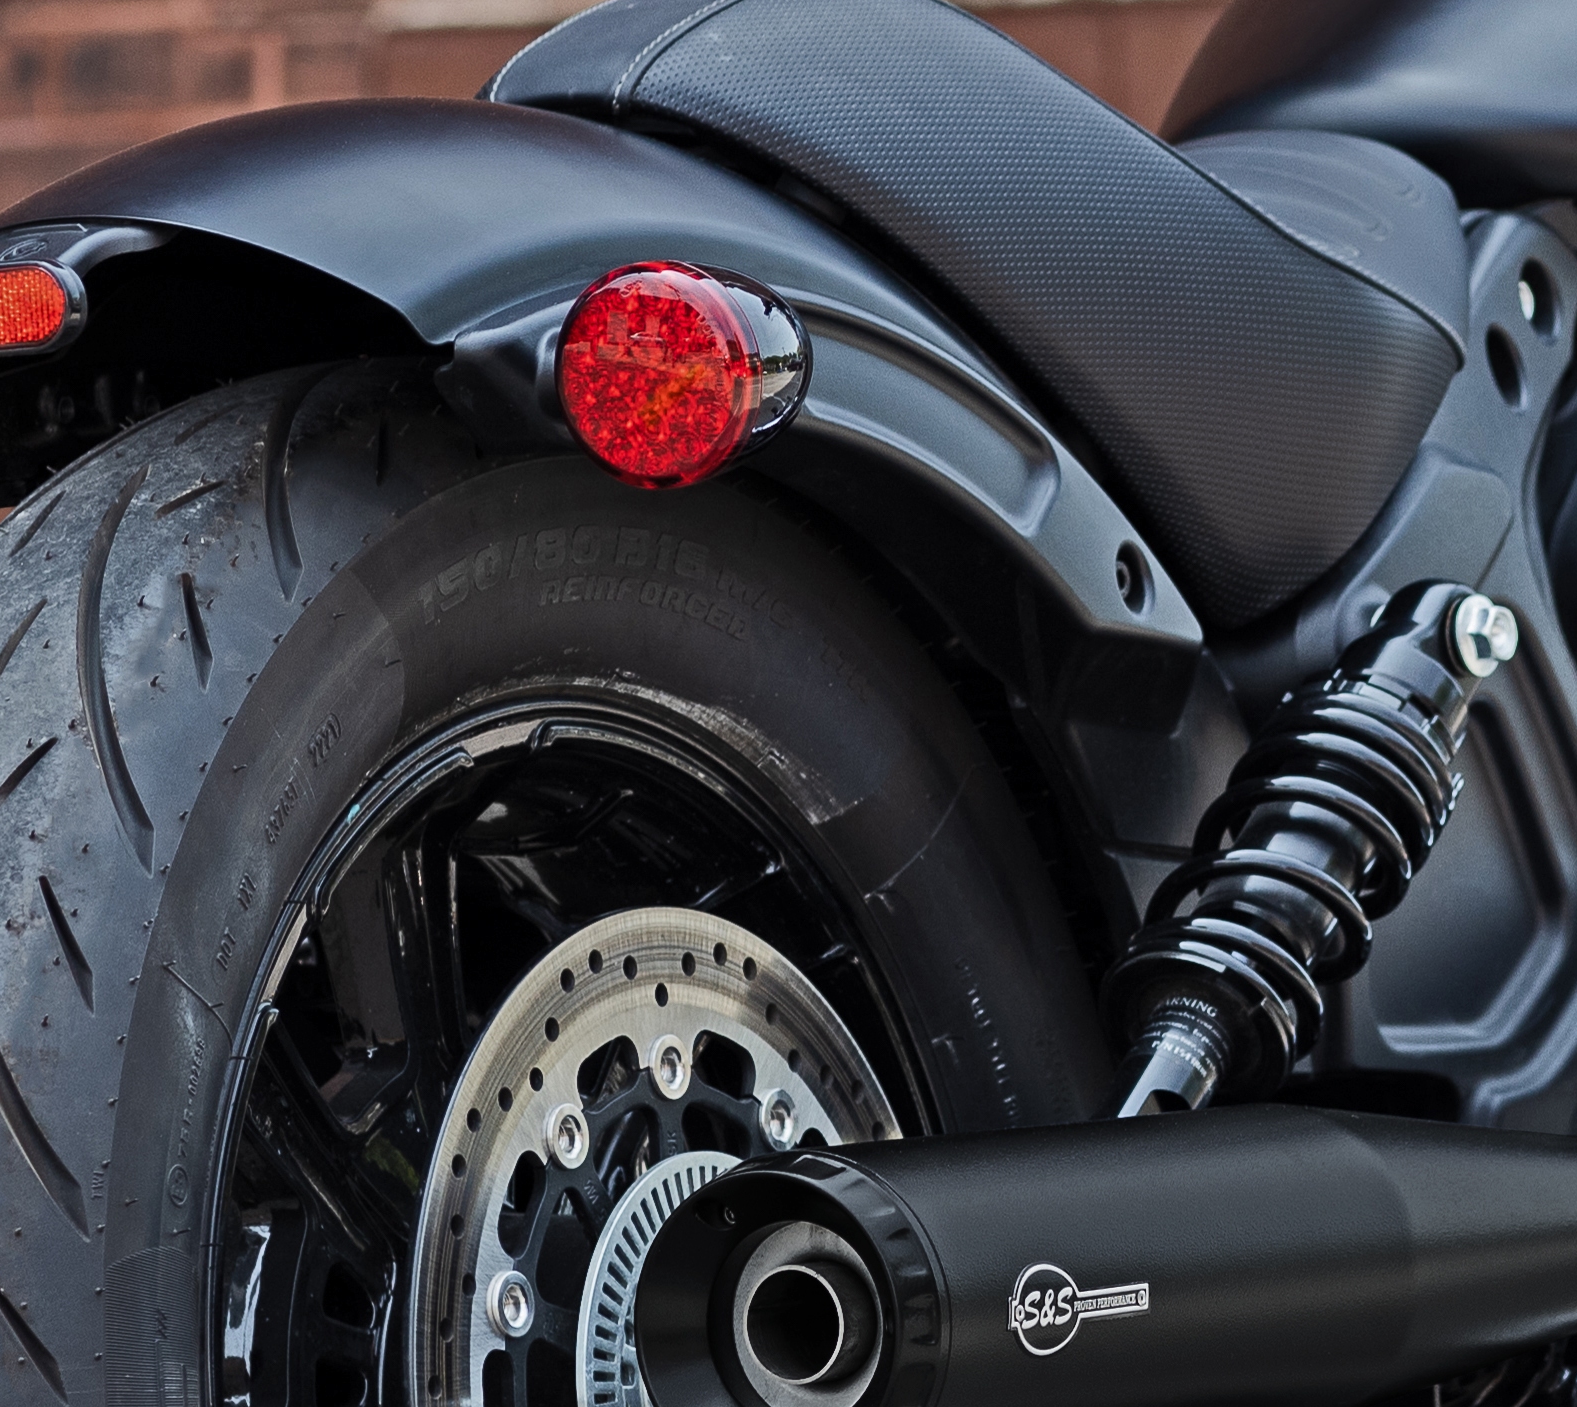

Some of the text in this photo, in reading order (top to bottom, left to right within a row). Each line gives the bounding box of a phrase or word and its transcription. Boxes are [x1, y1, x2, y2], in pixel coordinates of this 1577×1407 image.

[418, 524, 601, 625] 150/80
[1020, 1286, 1136, 1330] S&S PROVEN PERFORMANCE
